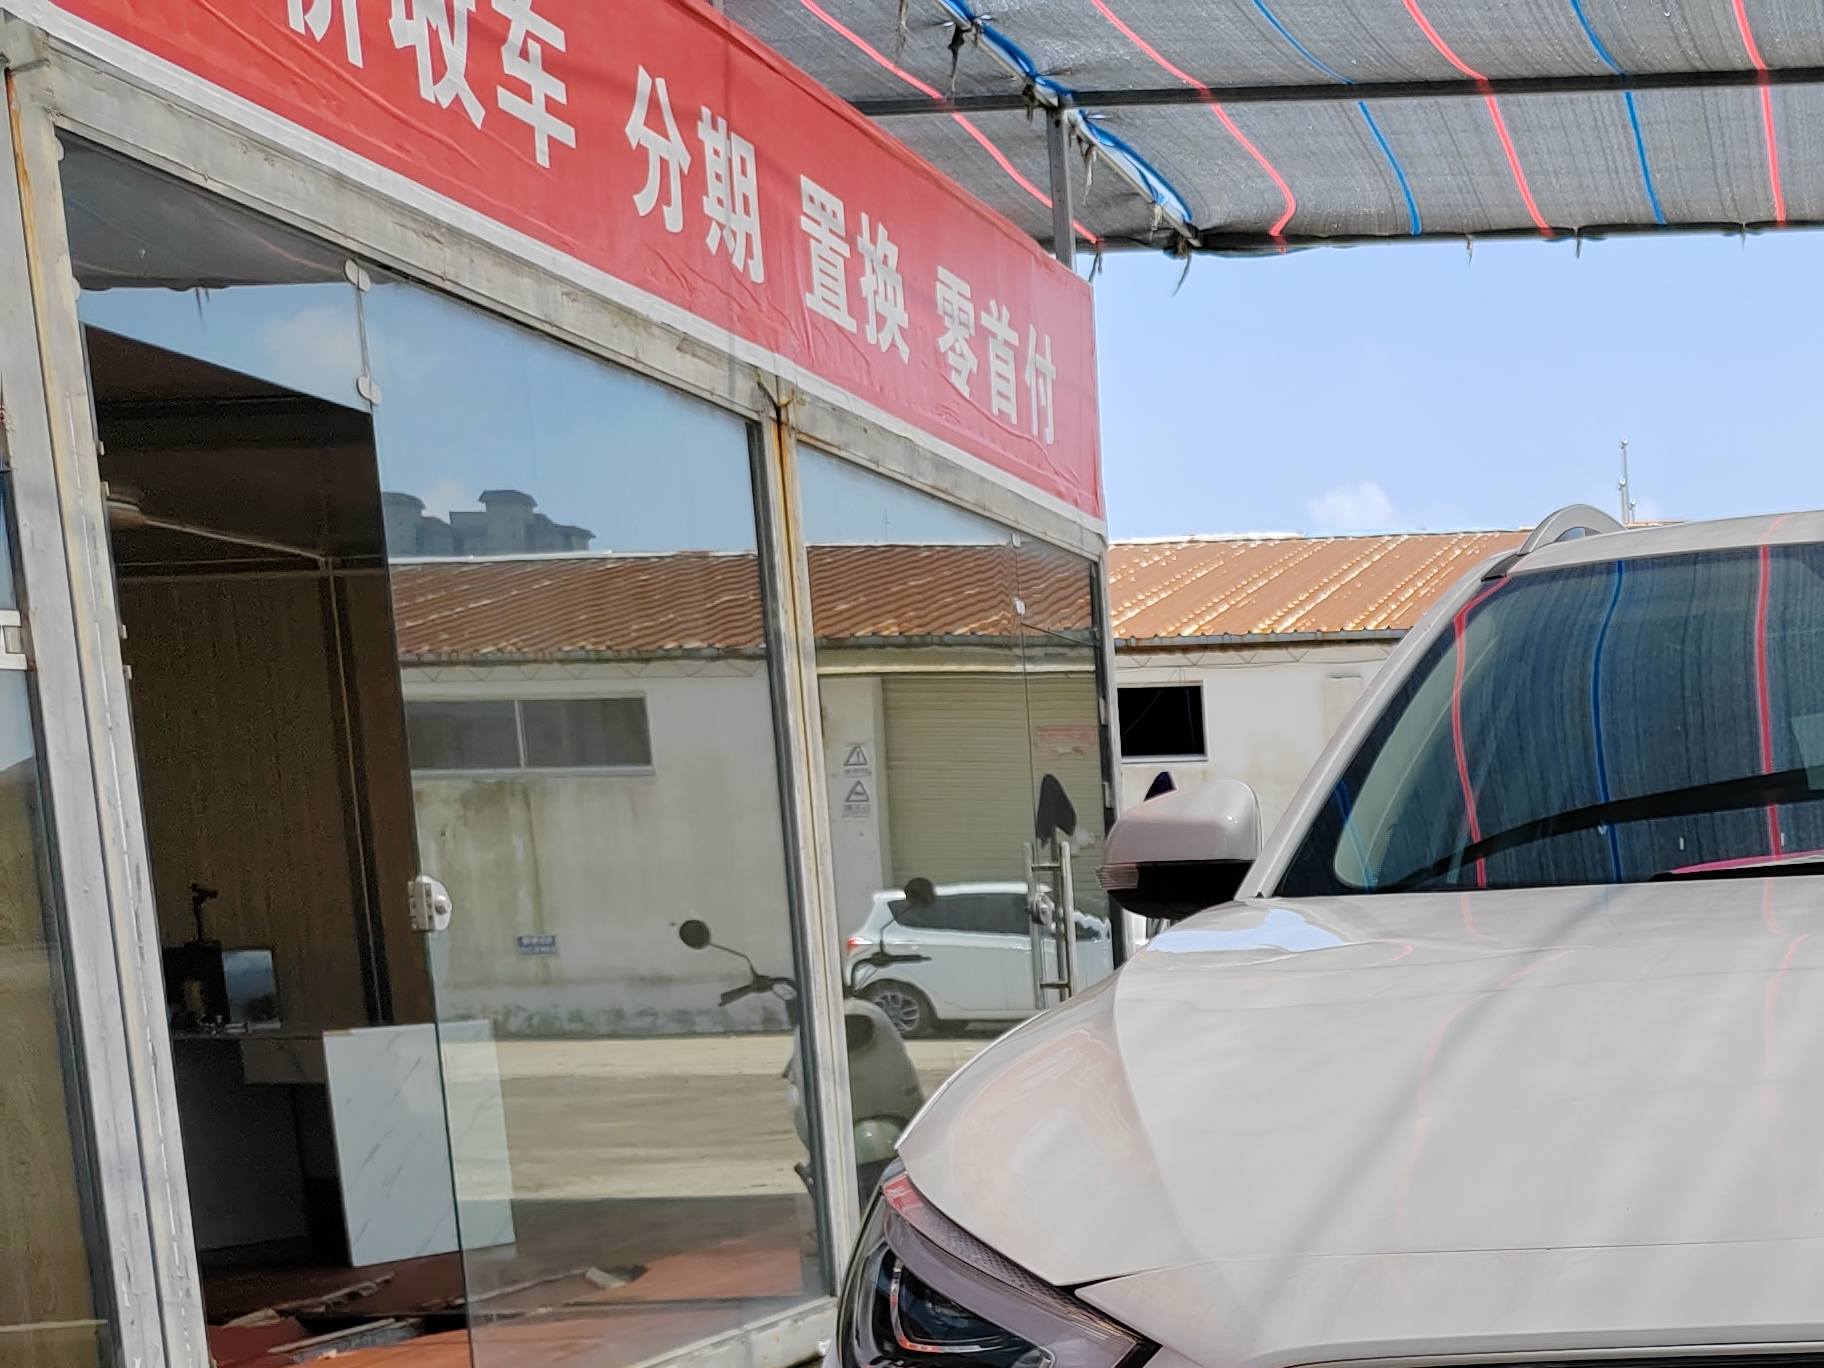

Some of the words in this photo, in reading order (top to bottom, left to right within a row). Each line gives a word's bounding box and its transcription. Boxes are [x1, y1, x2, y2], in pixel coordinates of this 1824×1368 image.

[624, 63, 765, 284] 分期
[799, 173, 911, 365] 置换
[935, 265, 1057, 445] 零首付
